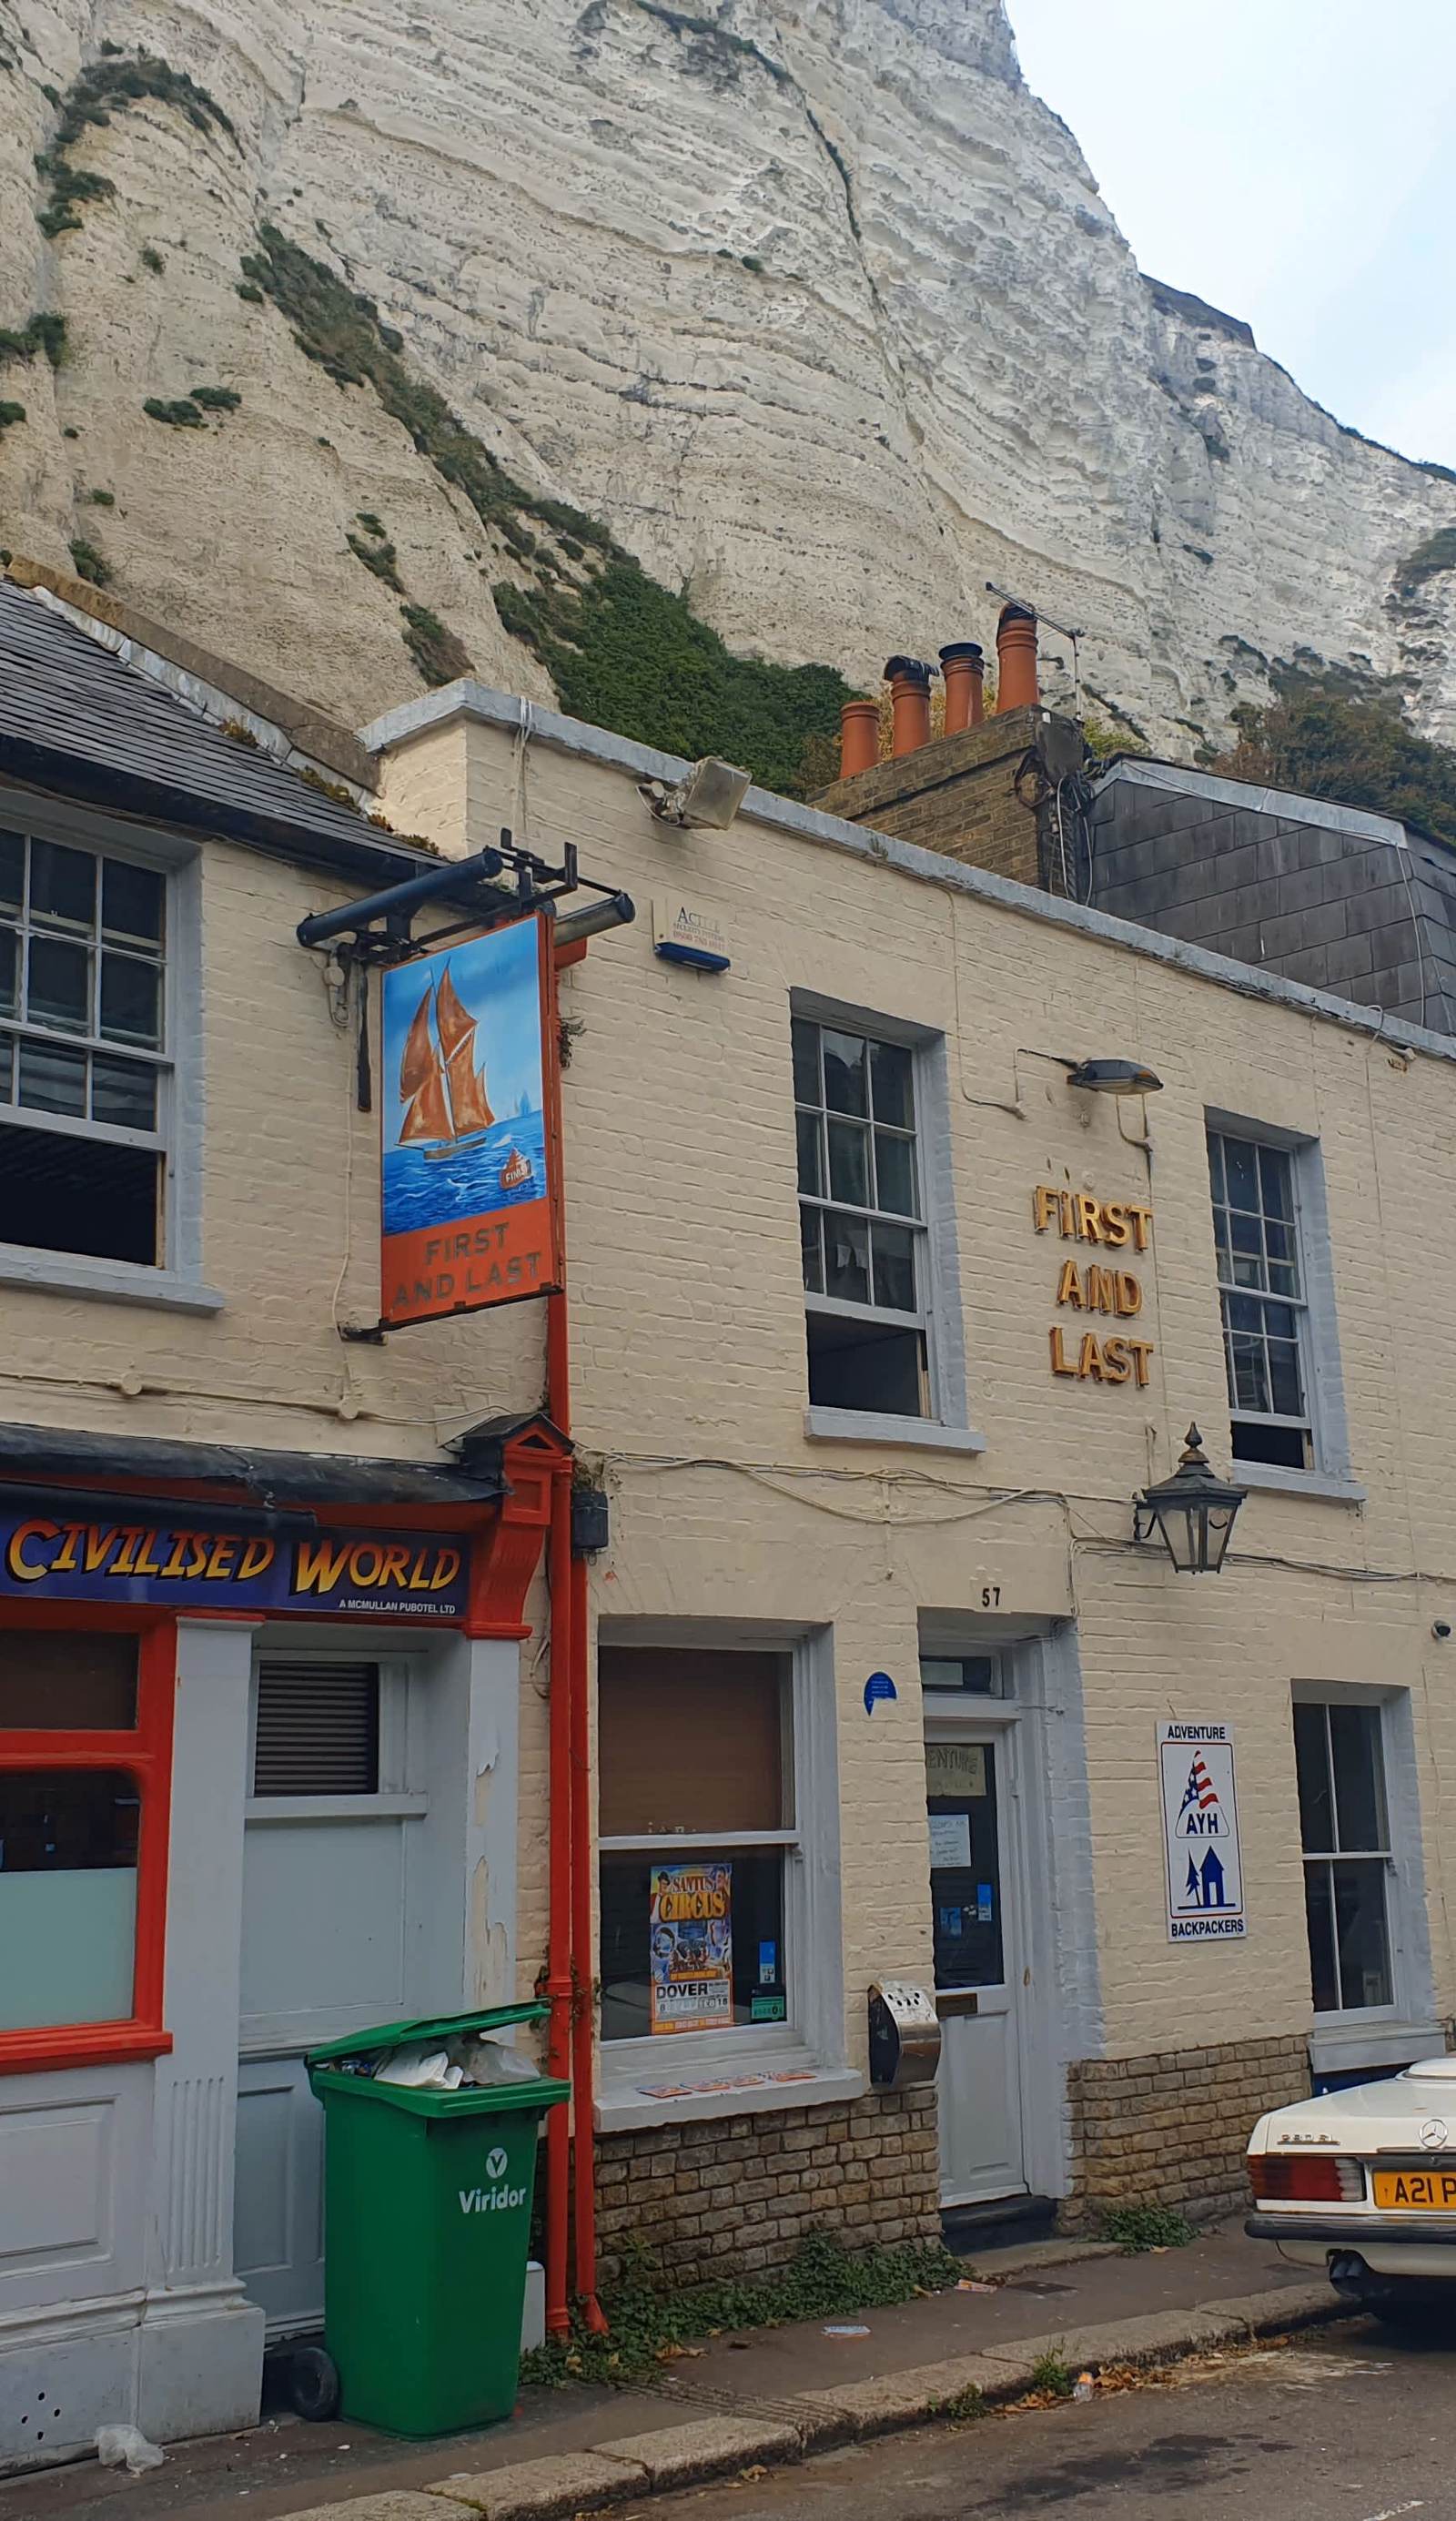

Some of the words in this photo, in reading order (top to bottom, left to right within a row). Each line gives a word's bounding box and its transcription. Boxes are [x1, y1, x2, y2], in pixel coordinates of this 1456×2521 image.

[1033, 1186, 1153, 1251] FIRST
[424, 1222, 510, 1266] FIRST
[391, 1273, 453, 1311] AND
[466, 1252, 541, 1293] LAST
[1057, 1259, 1143, 1317] AND
[1049, 1326, 1154, 1386] LAST
[7, 1518, 274, 1583] CIVILISED
[293, 1540, 460, 1594] WORLD
[339, 1599, 346, 1608] A
[348, 1599, 398, 1611] MCMULLAN
[399, 1602, 438, 1614] PUBOTEL
[440, 1605, 455, 1615] LTD
[982, 1587, 1000, 1607] 57
[1168, 1726, 1225, 1740] ADVENTURE
[1187, 1814, 1218, 1835] AYH
[660, 1892, 725, 1922] CIRCUS
[1171, 1919, 1244, 1938] BACKPACKERS
[656, 1982, 708, 2000] DOVER
[459, 2184, 526, 2213] Viridor
[1395, 2177, 1434, 2202] A21
